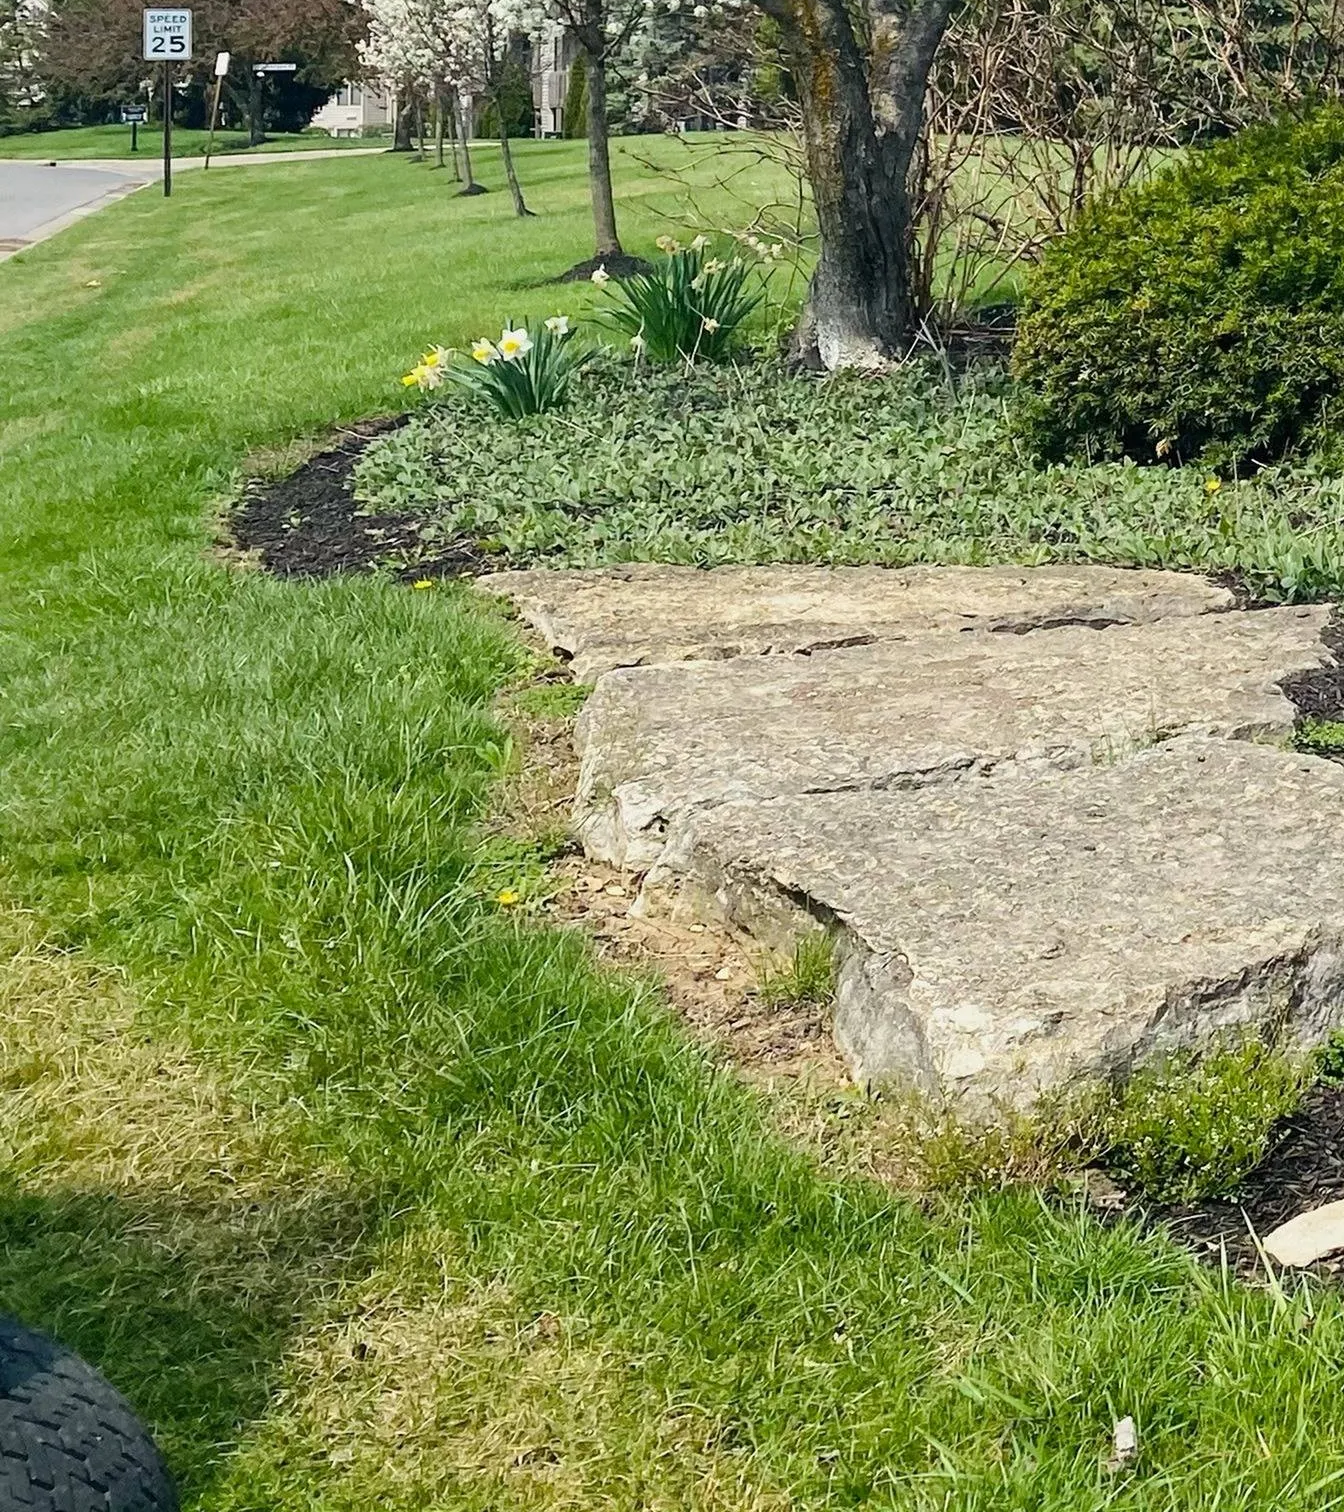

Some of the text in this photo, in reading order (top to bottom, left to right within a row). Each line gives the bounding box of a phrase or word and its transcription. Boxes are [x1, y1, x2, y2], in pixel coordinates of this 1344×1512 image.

[149, 15, 187, 23] SPEED
[153, 25, 182, 33] LIMIT
[152, 36, 186, 53] 25
